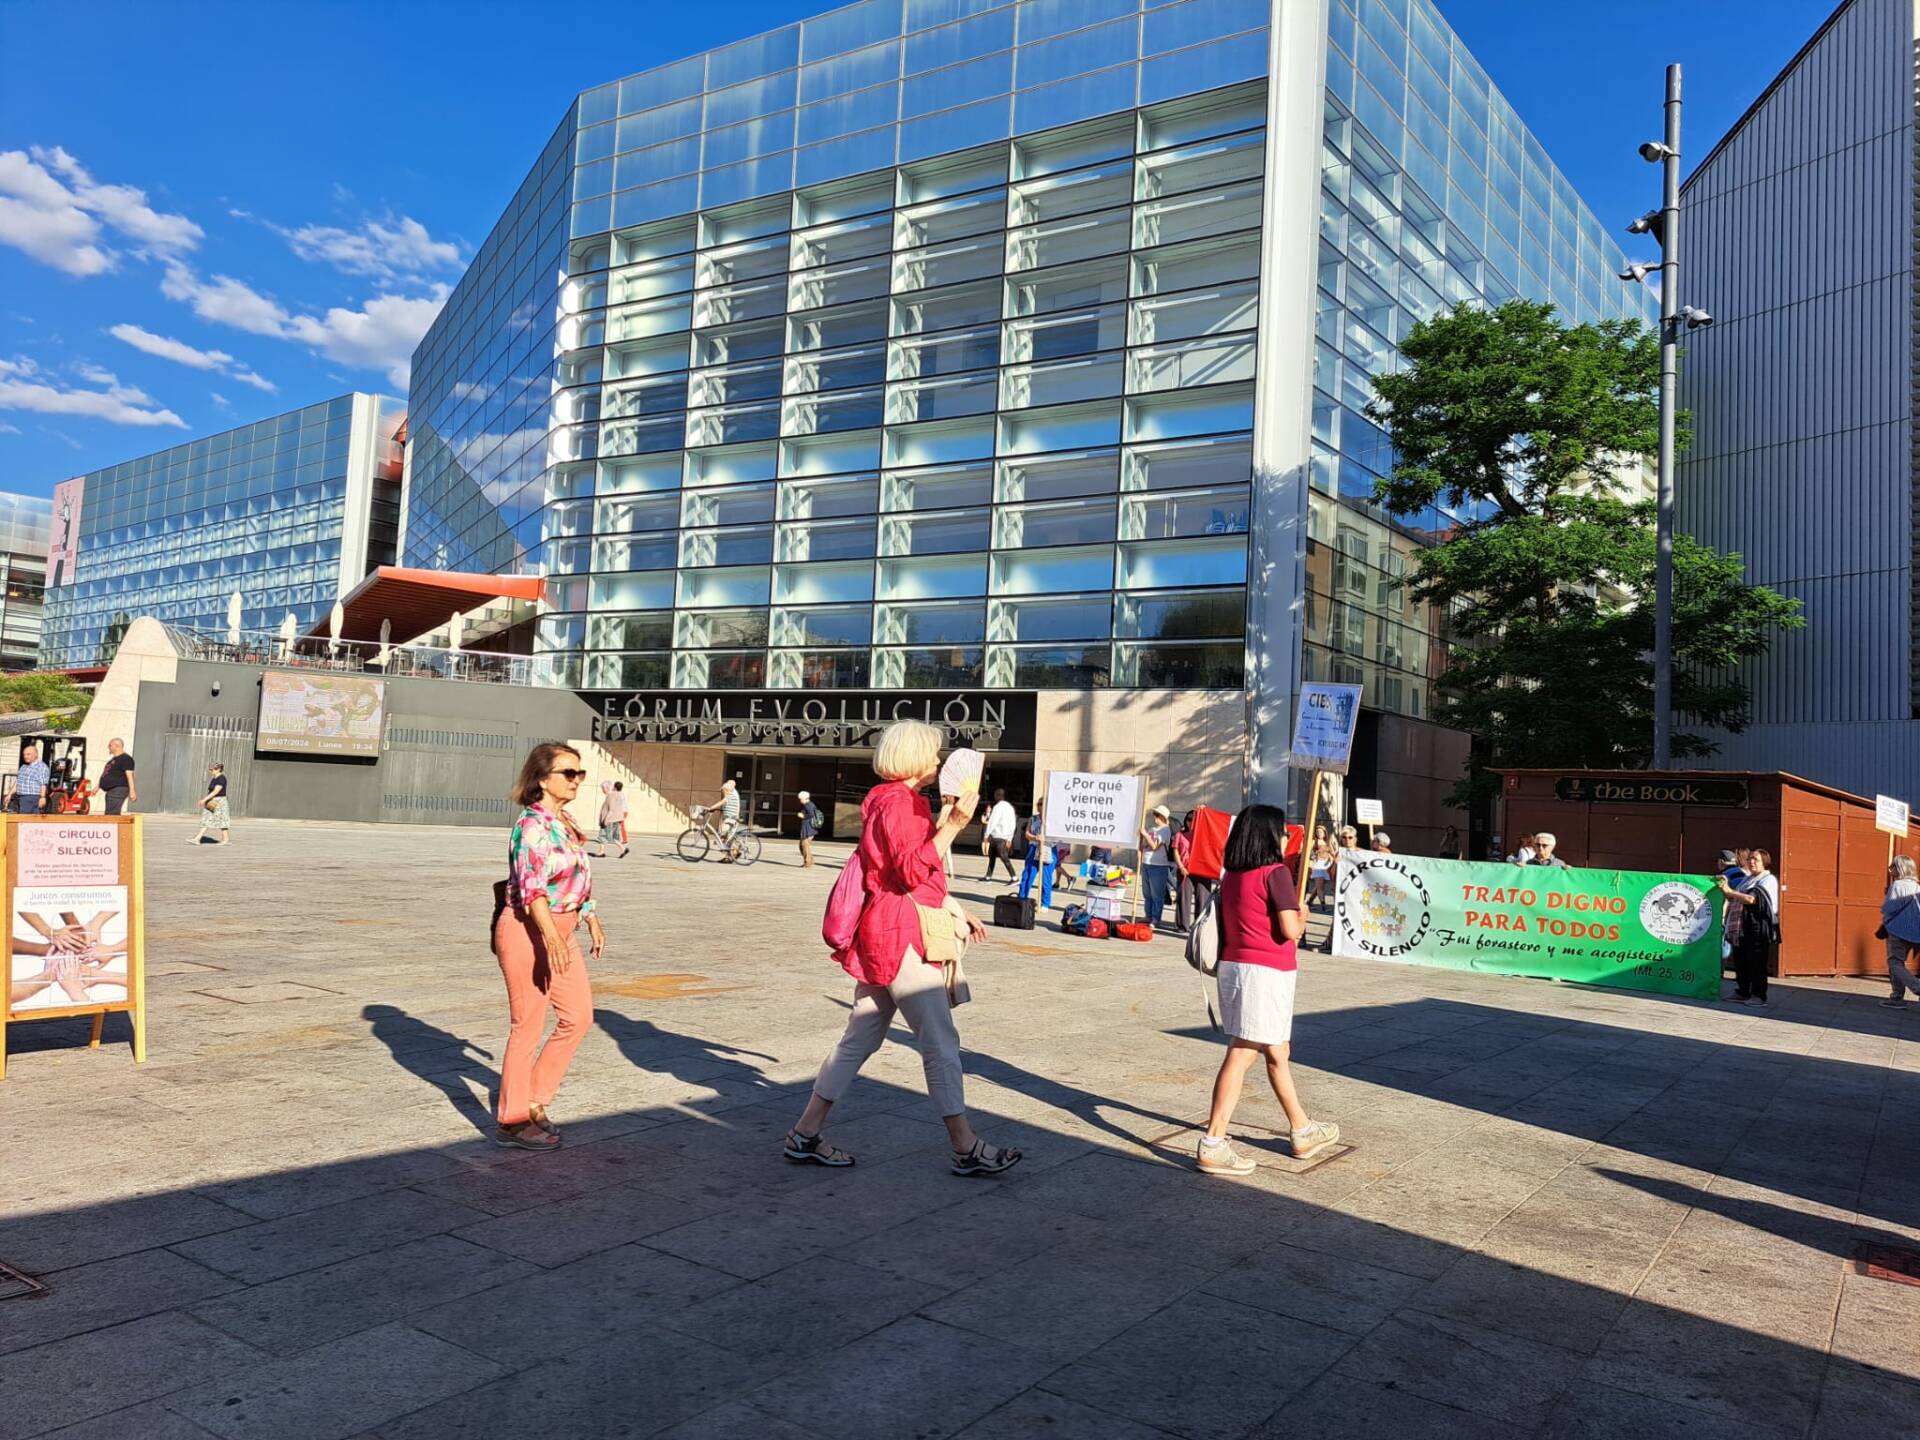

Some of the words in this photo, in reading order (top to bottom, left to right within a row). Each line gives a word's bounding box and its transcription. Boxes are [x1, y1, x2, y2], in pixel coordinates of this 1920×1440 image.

[604, 693, 723, 724] FÓRUM
[750, 694, 1006, 730] EVOLUCIÓN
[1064, 777, 1095, 791] ¿Por
[1098, 779, 1123, 792] qué
[1594, 782, 1634, 799] the
[1071, 793, 1113, 806] vienen
[1067, 806, 1086, 819] los
[1091, 809, 1114, 822] que
[59, 829, 111, 839] CÍRCULO
[1064, 822, 1116, 836] vienen?
[57, 846, 112, 856] SILENCIO
[1339, 858, 1431, 907] CIRCULOS
[1462, 885, 1537, 907] TRATO
[1546, 892, 1627, 914] DIGNO
[1337, 901, 1355, 941] DEL
[1465, 911, 1527, 932] PARA
[1536, 917, 1621, 942] TODOS
[1358, 911, 1431, 957] SILENCIO
[1476, 934, 1541, 952] forastero
[1547, 945, 1555, 957] y
[1562, 945, 1583, 956] me
